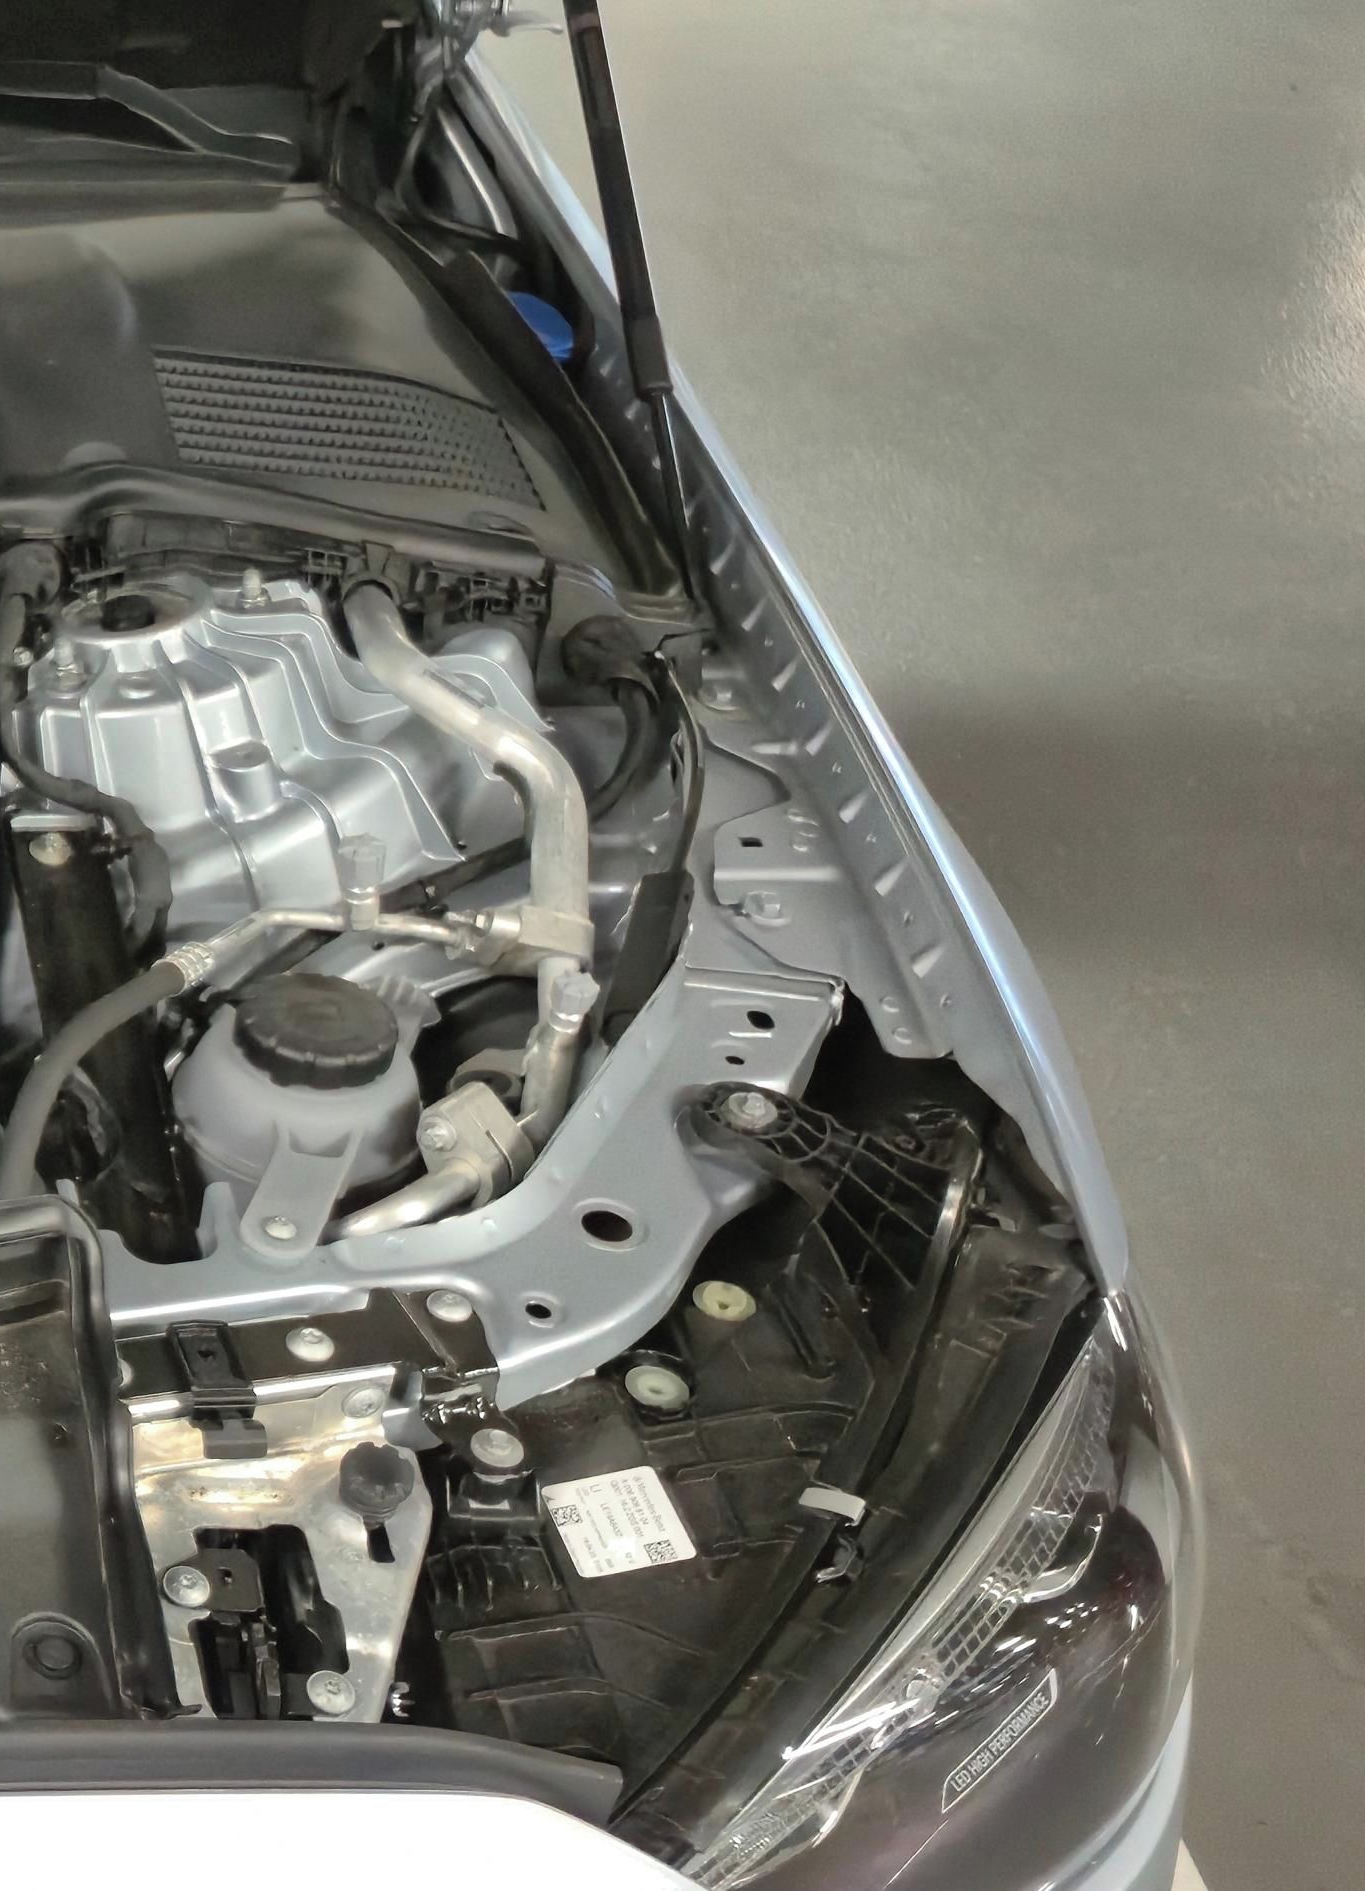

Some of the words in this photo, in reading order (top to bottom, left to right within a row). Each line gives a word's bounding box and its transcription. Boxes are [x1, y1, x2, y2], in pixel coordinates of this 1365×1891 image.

[950, 1769, 972, 1792] LED
[967, 1747, 995, 1777] HIGH
[988, 1691, 1050, 1756] PERFORMANCE
